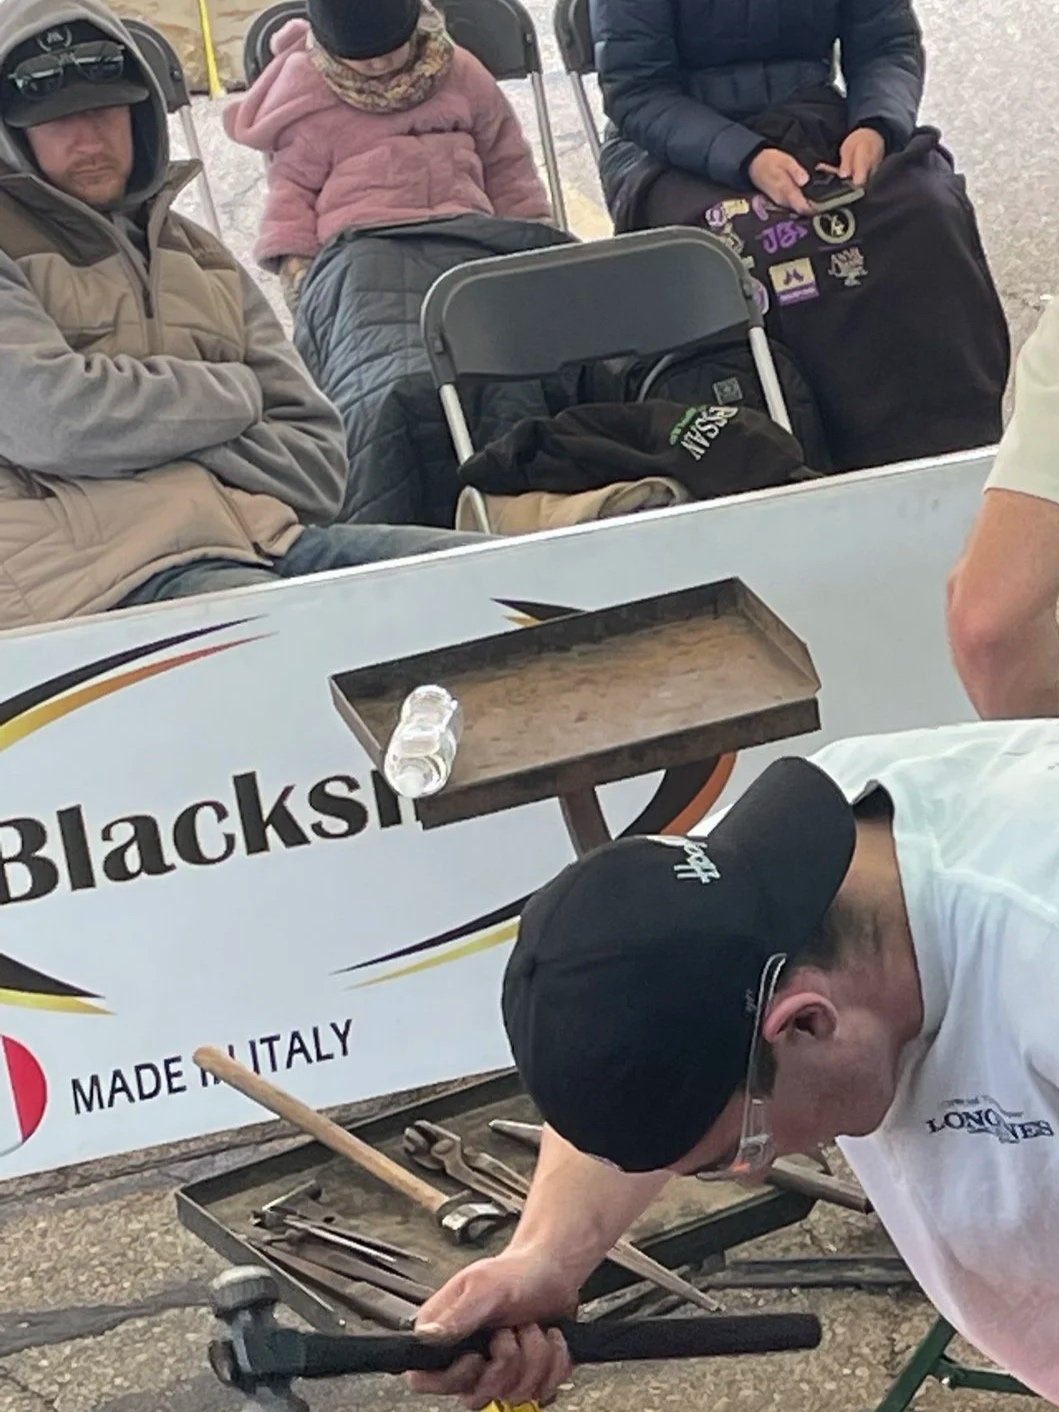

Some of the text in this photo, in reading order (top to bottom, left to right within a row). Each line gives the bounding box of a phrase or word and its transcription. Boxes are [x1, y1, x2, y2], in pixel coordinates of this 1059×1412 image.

[0, 770, 404, 906] Blacks
[71, 1055, 187, 1115] MADE
[248, 1019, 353, 1075] ITALY
